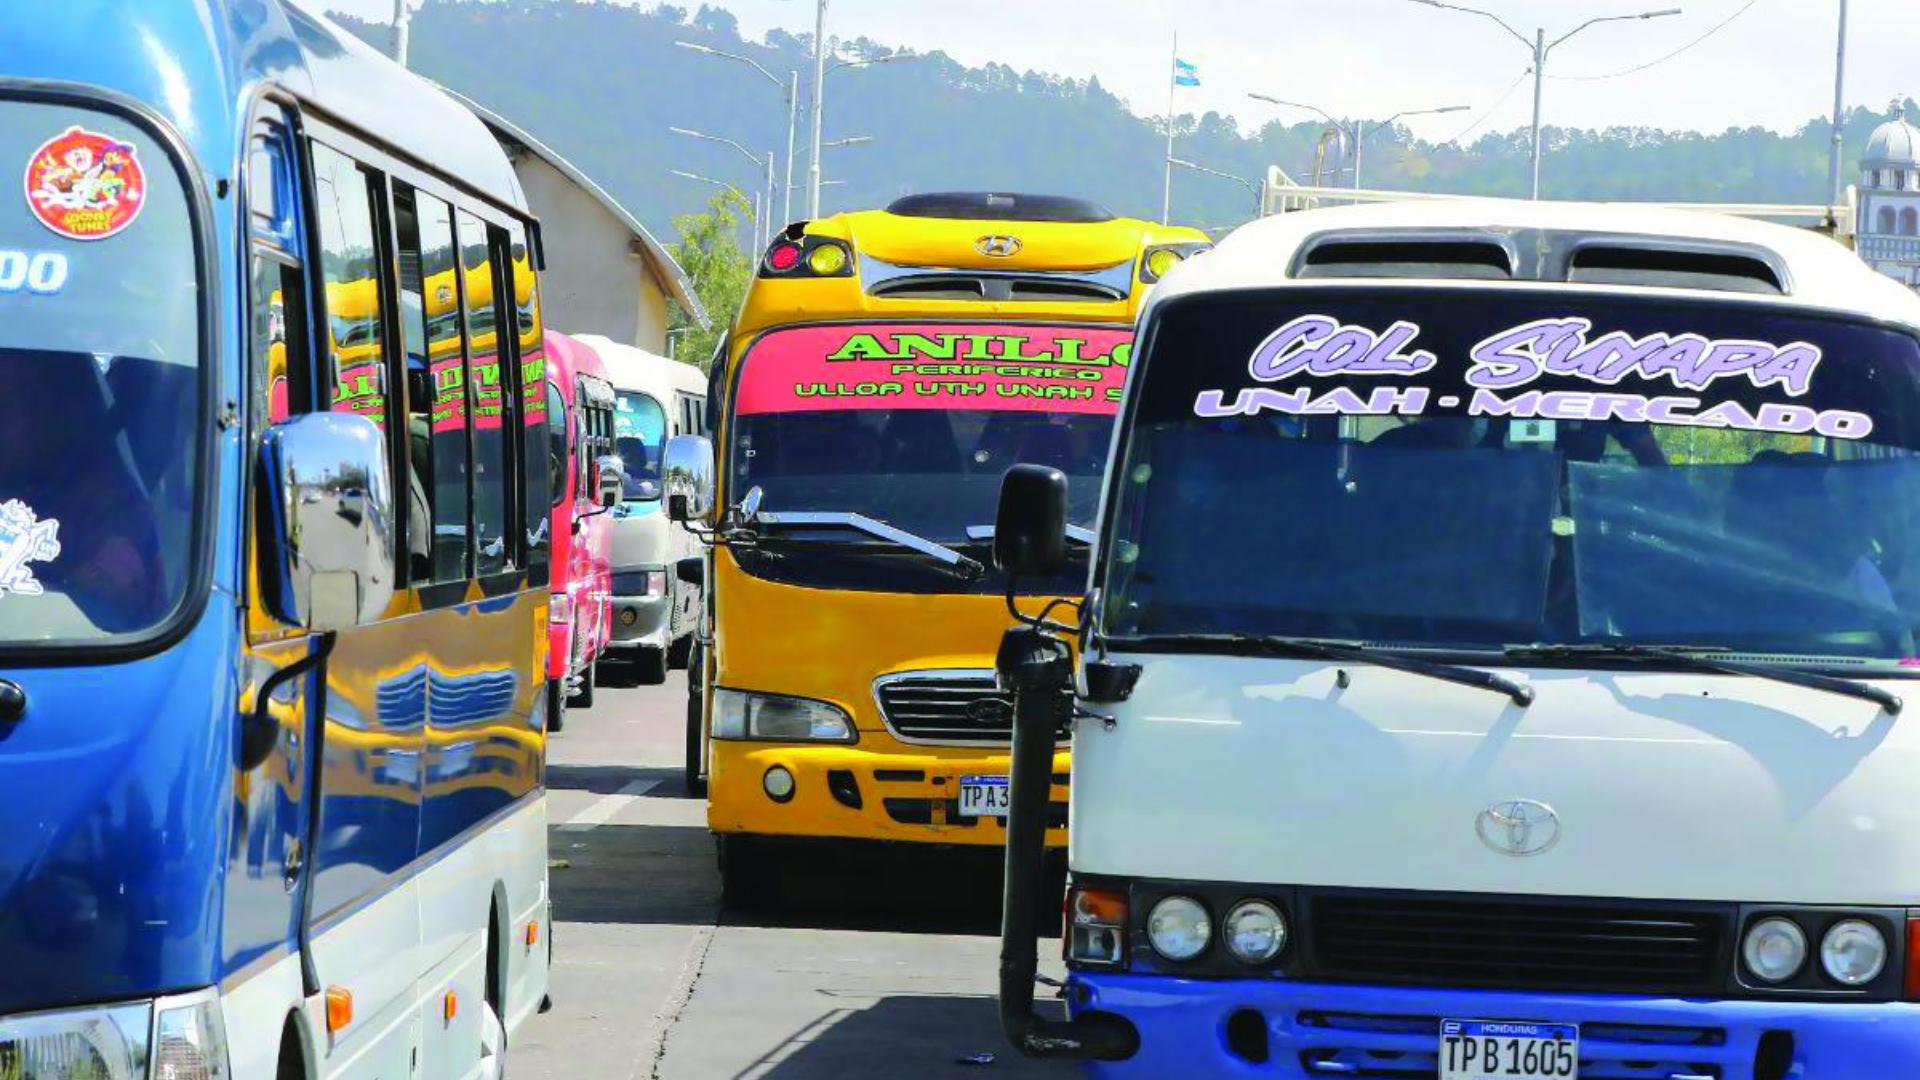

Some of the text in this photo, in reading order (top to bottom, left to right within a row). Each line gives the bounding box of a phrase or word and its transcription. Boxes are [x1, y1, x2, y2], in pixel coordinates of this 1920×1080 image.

[1249, 315, 1821, 396] COL. SUYAPA
[891, 364, 1102, 381] PERIFERICO
[794, 382, 903, 397] ULLOA
[914, 381, 985, 397] UTH
[995, 382, 1094, 399] UNAH
[1194, 388, 1429, 418] UNAH
[1469, 388, 1872, 439] MERCADO
[1480, 1023, 1538, 1035] HONDURAS
